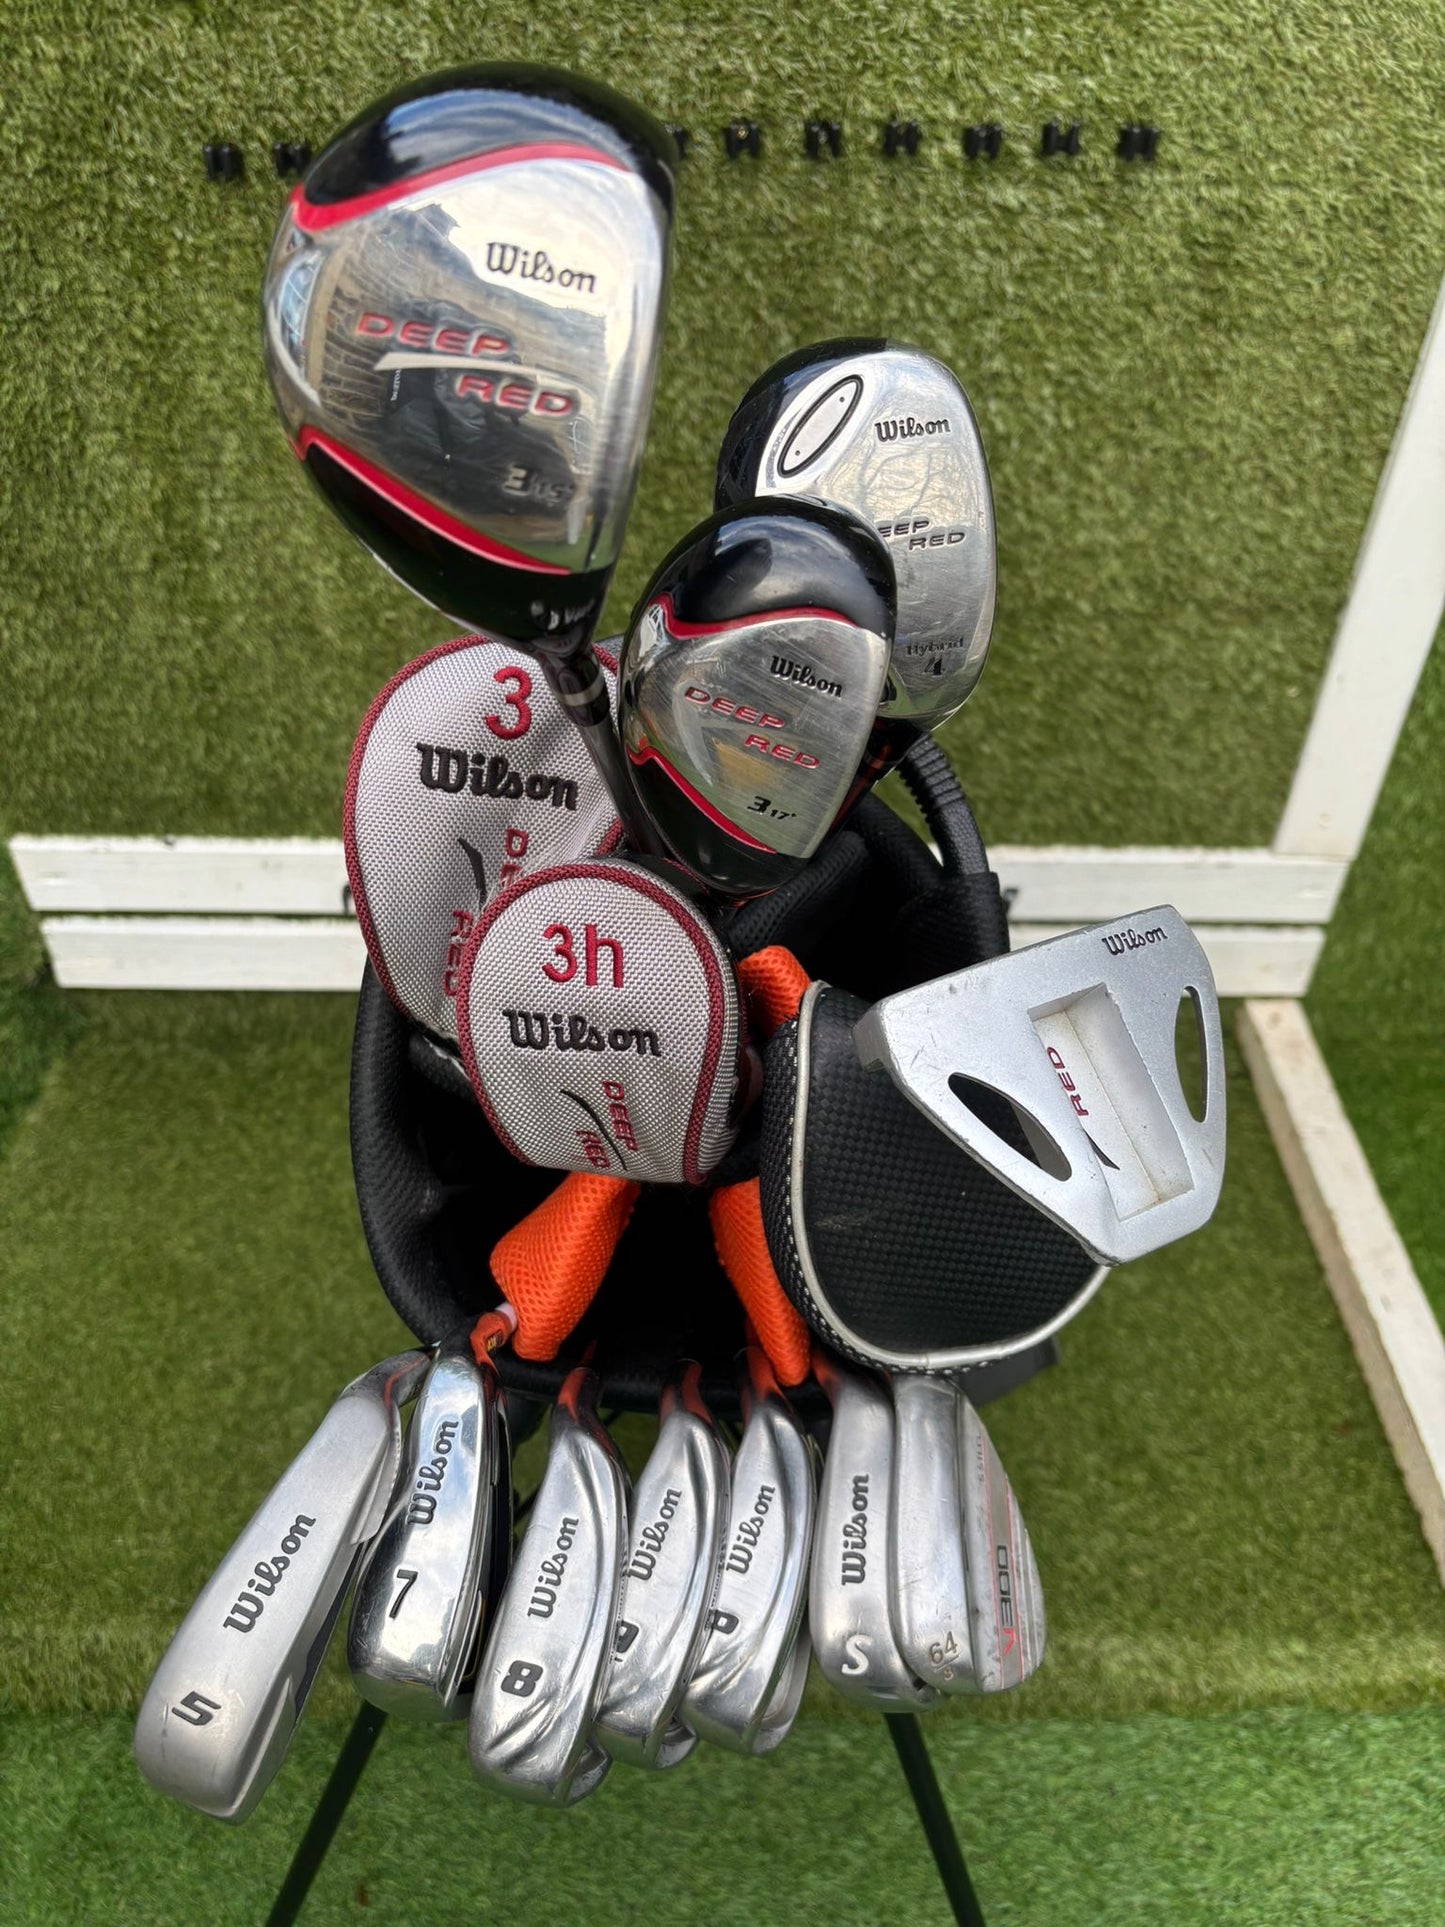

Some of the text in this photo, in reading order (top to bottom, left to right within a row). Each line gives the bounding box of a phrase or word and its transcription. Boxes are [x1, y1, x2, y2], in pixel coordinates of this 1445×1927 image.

[486, 241, 596, 294] Wilson
[356, 312, 508, 357] DEEP
[455, 376, 573, 416] RED
[874, 415, 952, 443] Wilson
[878, 520, 931, 538] EEP
[909, 532, 966, 550] RED
[907, 638, 964, 657] Hybrid
[924, 657, 943, 676] 4
[770, 655, 843, 698] Wilson
[485, 665, 533, 740] 3
[683, 685, 787, 729] DEEP
[744, 734, 820, 770] RED
[417, 741, 579, 811] Wilson
[747, 796, 772, 813] 3
[541, 923, 626, 989] 3h
[1101, 924, 1168, 957] Wilson
[503, 1008, 663, 1058] Wilson
[1046, 1045, 1090, 1117] RED
[602, 1080, 639, 1151] DEEP
[575, 1130, 611, 1168] RED
[407, 1420, 459, 1526] Wilson
[628, 1488, 682, 1581] Wilson
[726, 1483, 776, 1575] Wilson
[841, 1473, 870, 1586] Wilson
[223, 1514, 317, 1634] Wilson
[527, 1516, 579, 1619] Wilson
[389, 1569, 418, 1619] 7
[841, 1634, 874, 1675] S
[500, 1660, 544, 1698] 8
[171, 1690, 222, 1727] 5
